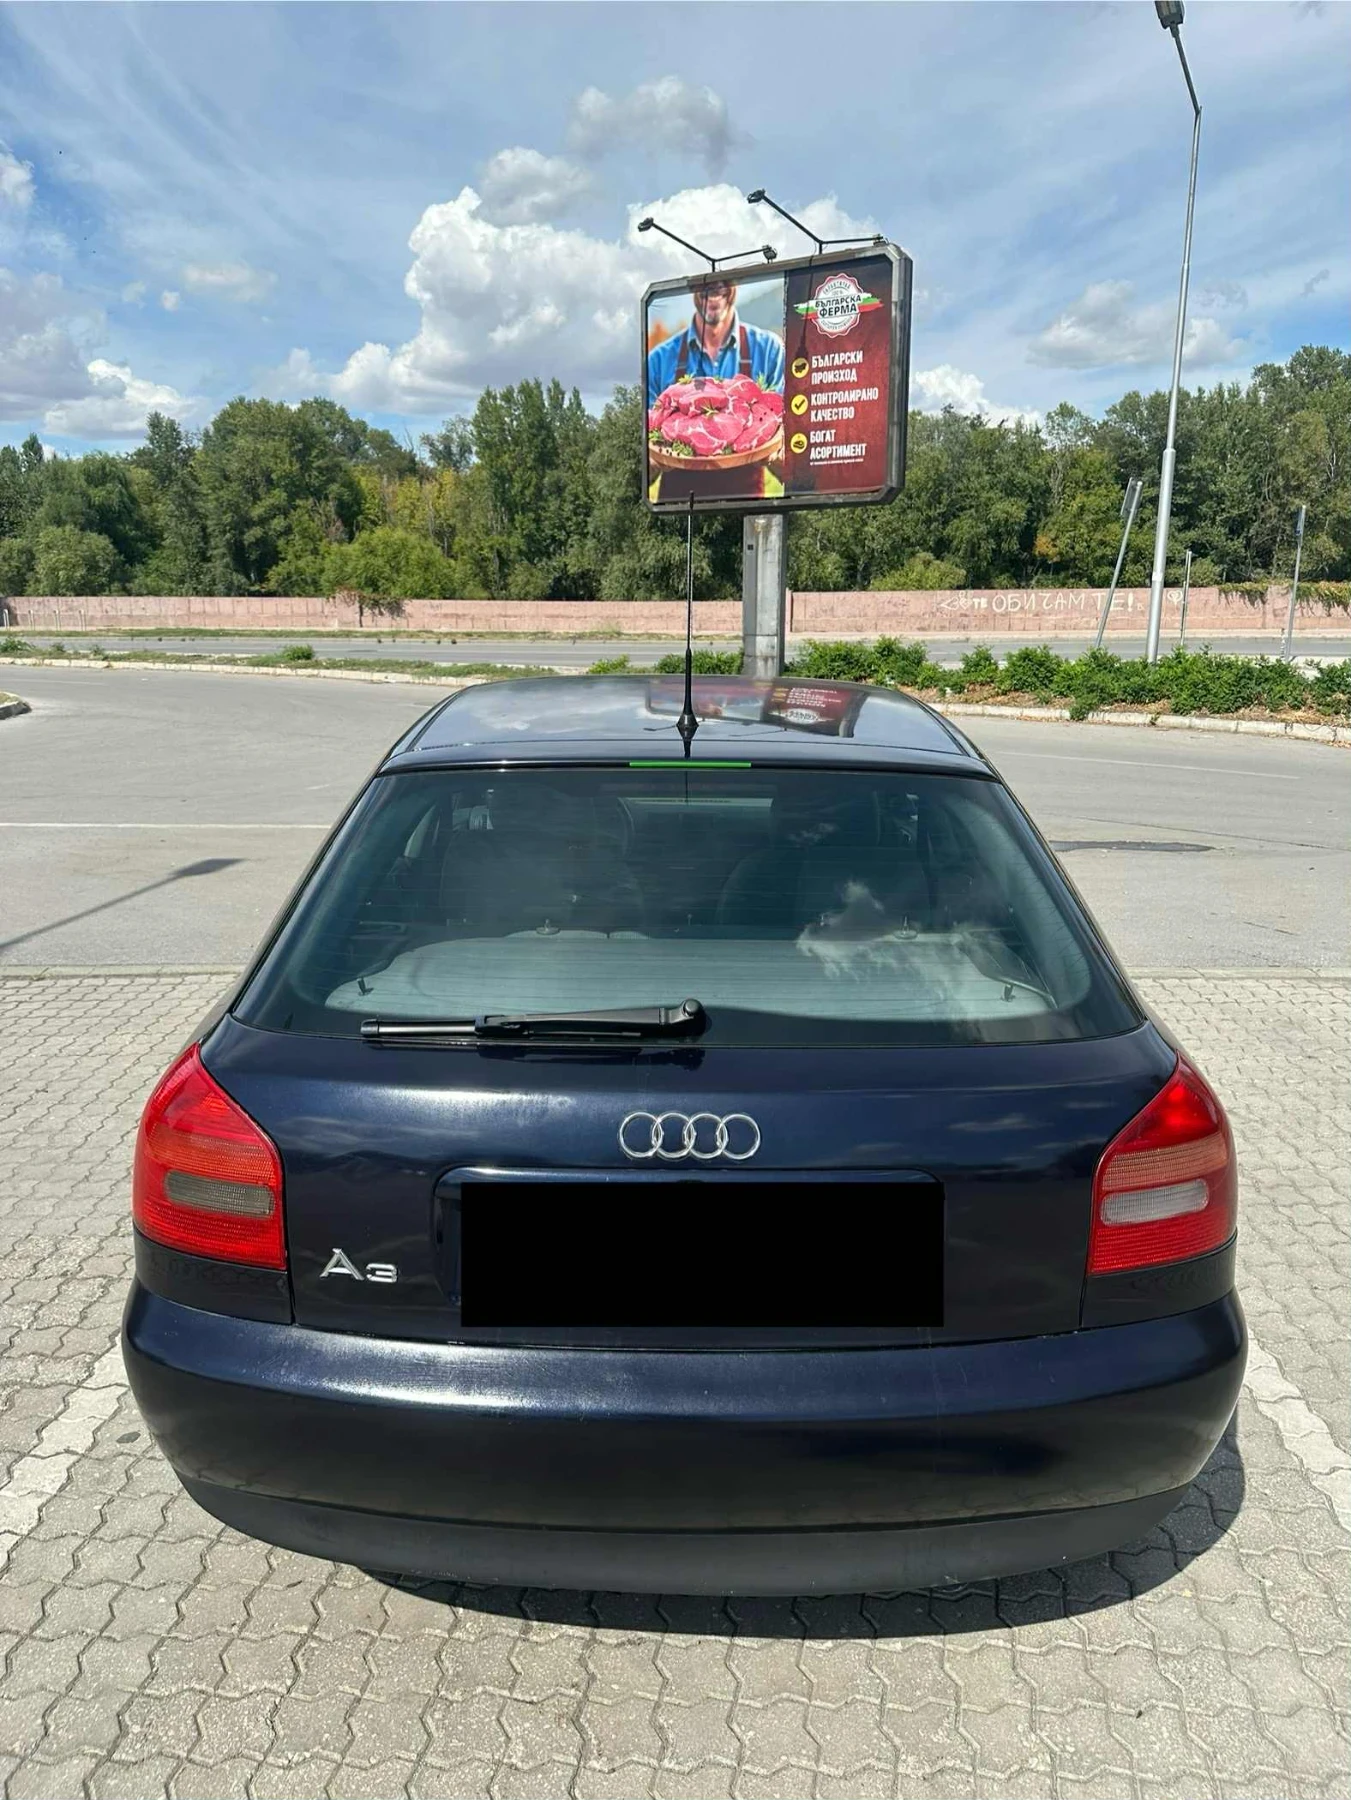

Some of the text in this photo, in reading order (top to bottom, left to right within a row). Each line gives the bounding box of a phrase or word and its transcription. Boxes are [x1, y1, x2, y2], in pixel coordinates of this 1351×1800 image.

[815, 294, 862, 308] БЪЛГАРСКА
[819, 303, 857, 318] ФЕРМА
[811, 350, 864, 369] БЪЛГАРСКИ
[811, 368, 858, 385] ПРОИЗХОД
[810, 387, 879, 406] КОНТРОЛИРАНО
[810, 406, 855, 423] КАЧЕСТВО
[809, 429, 836, 444] БОГАТ
[809, 443, 867, 460] АСОРТИМЕНТ
[319, 1247, 397, 1283] A3
